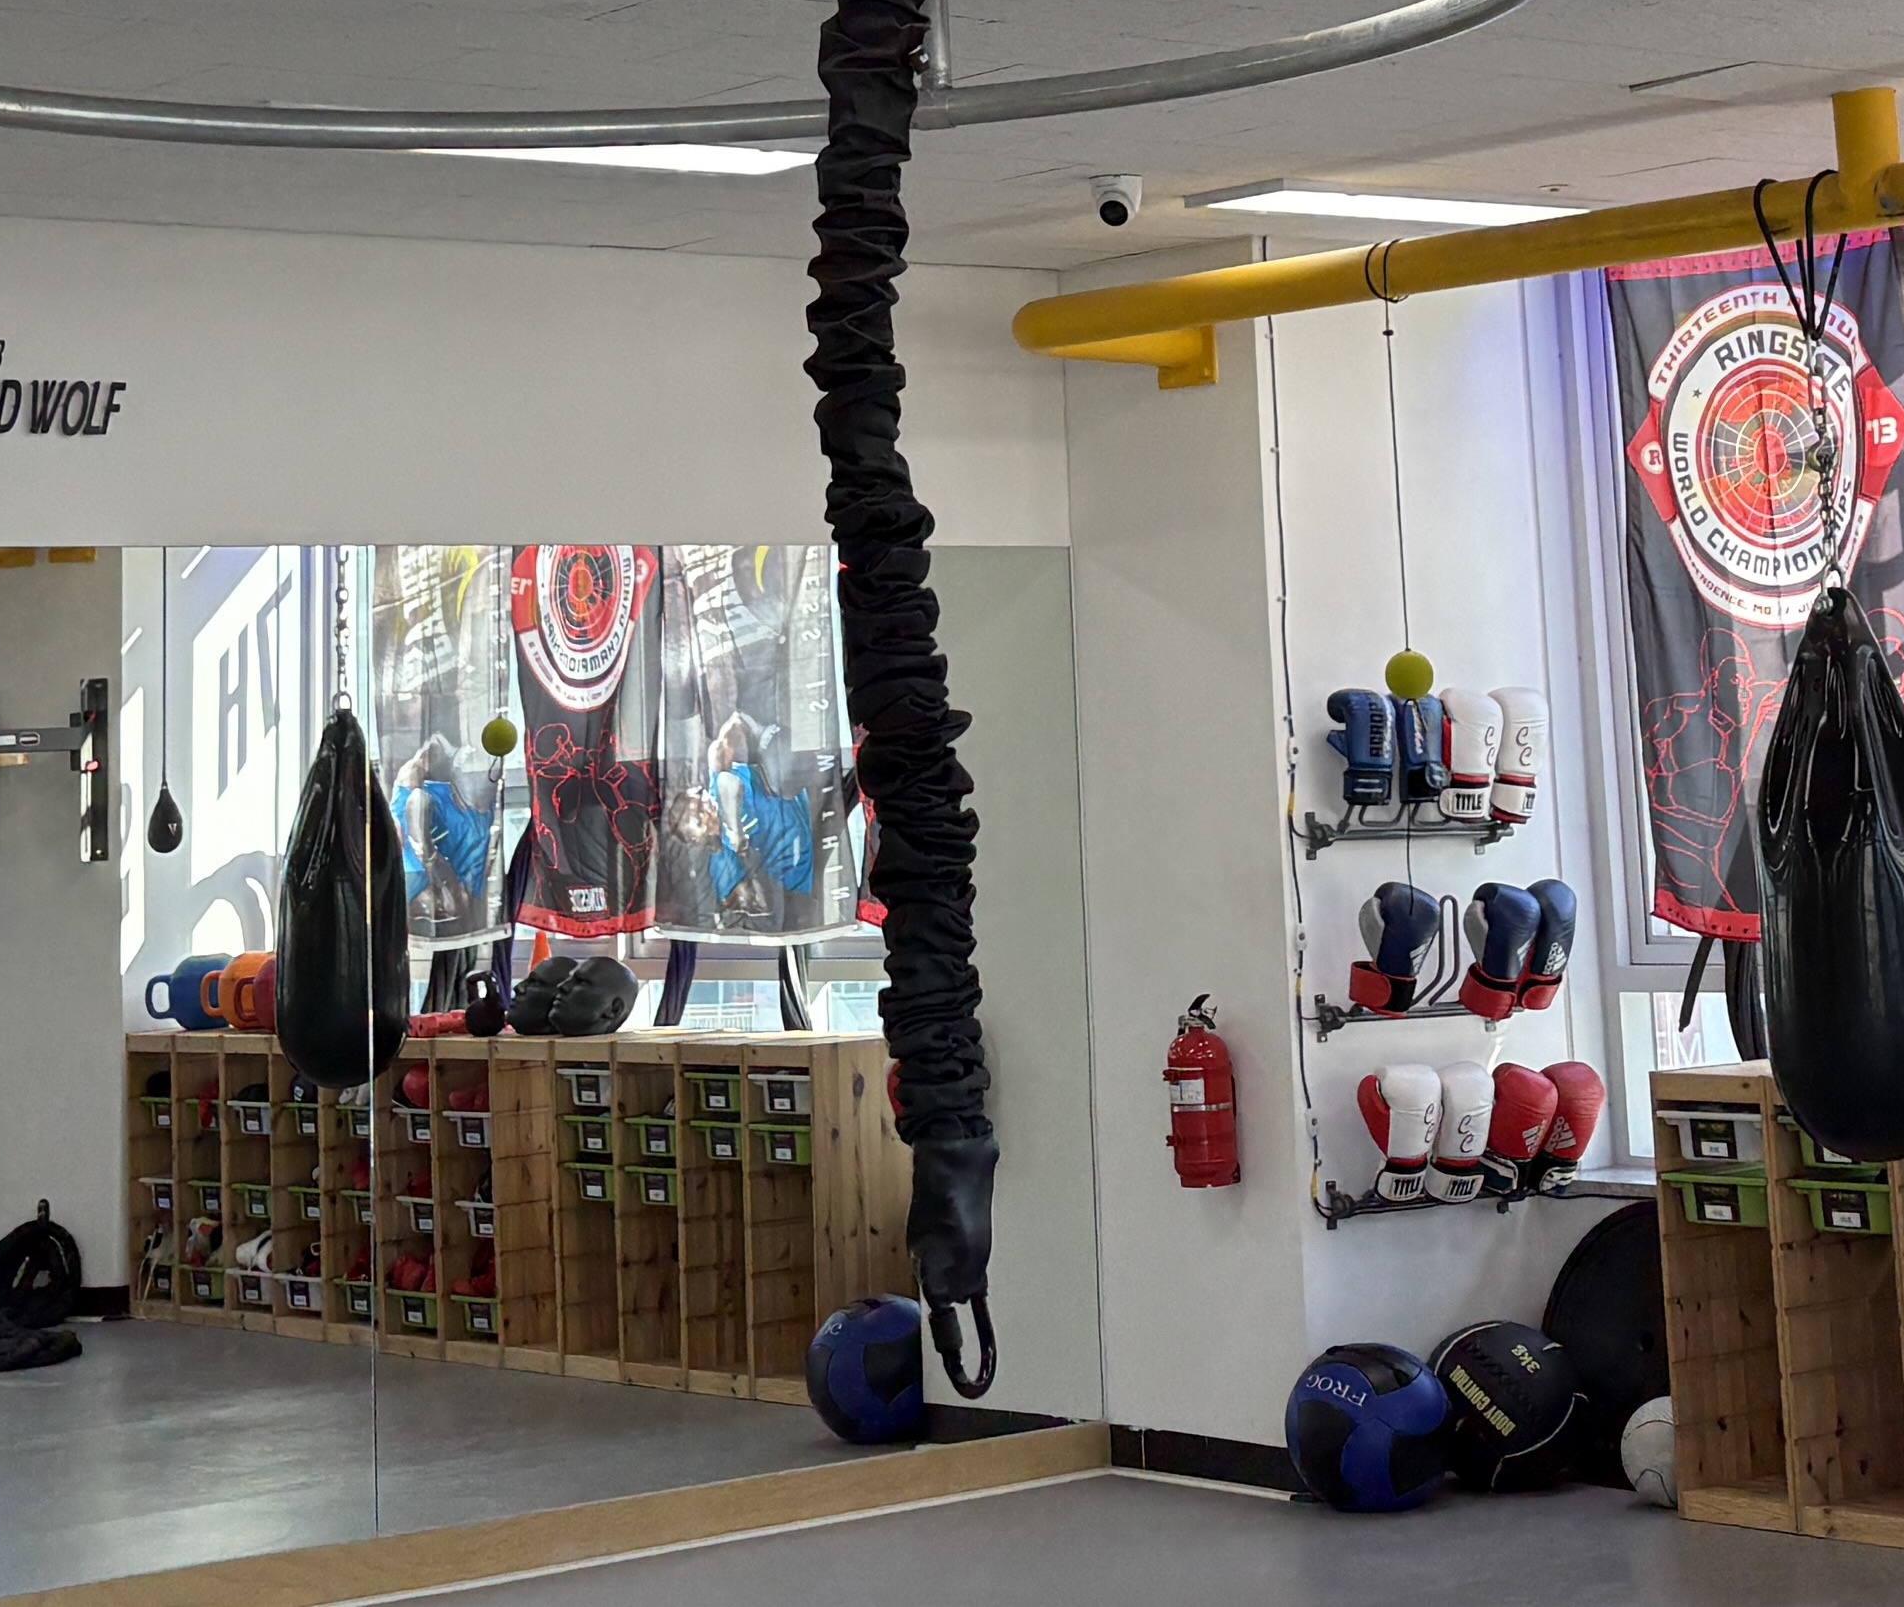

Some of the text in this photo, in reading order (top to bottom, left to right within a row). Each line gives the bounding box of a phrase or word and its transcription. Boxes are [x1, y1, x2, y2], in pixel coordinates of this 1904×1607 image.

[1656, 290, 1778, 386] THIRTEENTH
[29, 379, 127, 435] WOLF
[1670, 431, 1709, 527] WORLD
[1454, 793, 1483, 812] TITLE
[1448, 1363, 1518, 1438] BODY CONTROL
